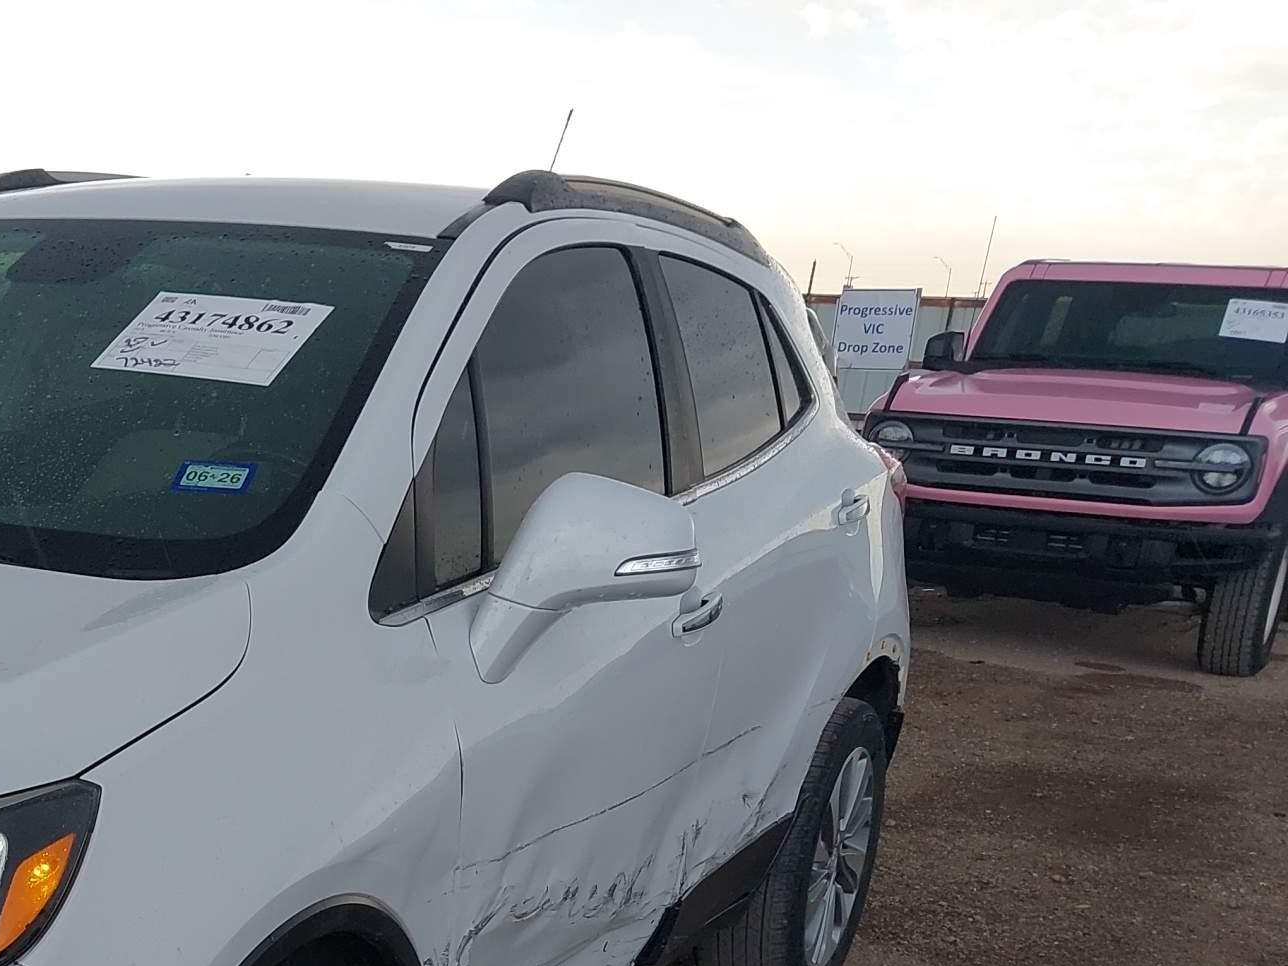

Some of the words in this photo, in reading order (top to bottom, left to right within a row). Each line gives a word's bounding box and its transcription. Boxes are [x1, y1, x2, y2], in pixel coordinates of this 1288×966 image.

[839, 304, 914, 318] Progressive
[153, 308, 295, 335] 43174862
[863, 323, 885, 335] VIC
[837, 341, 868, 356] Drop
[871, 342, 905, 354] Zone
[950, 444, 1147, 469] BRONCO
